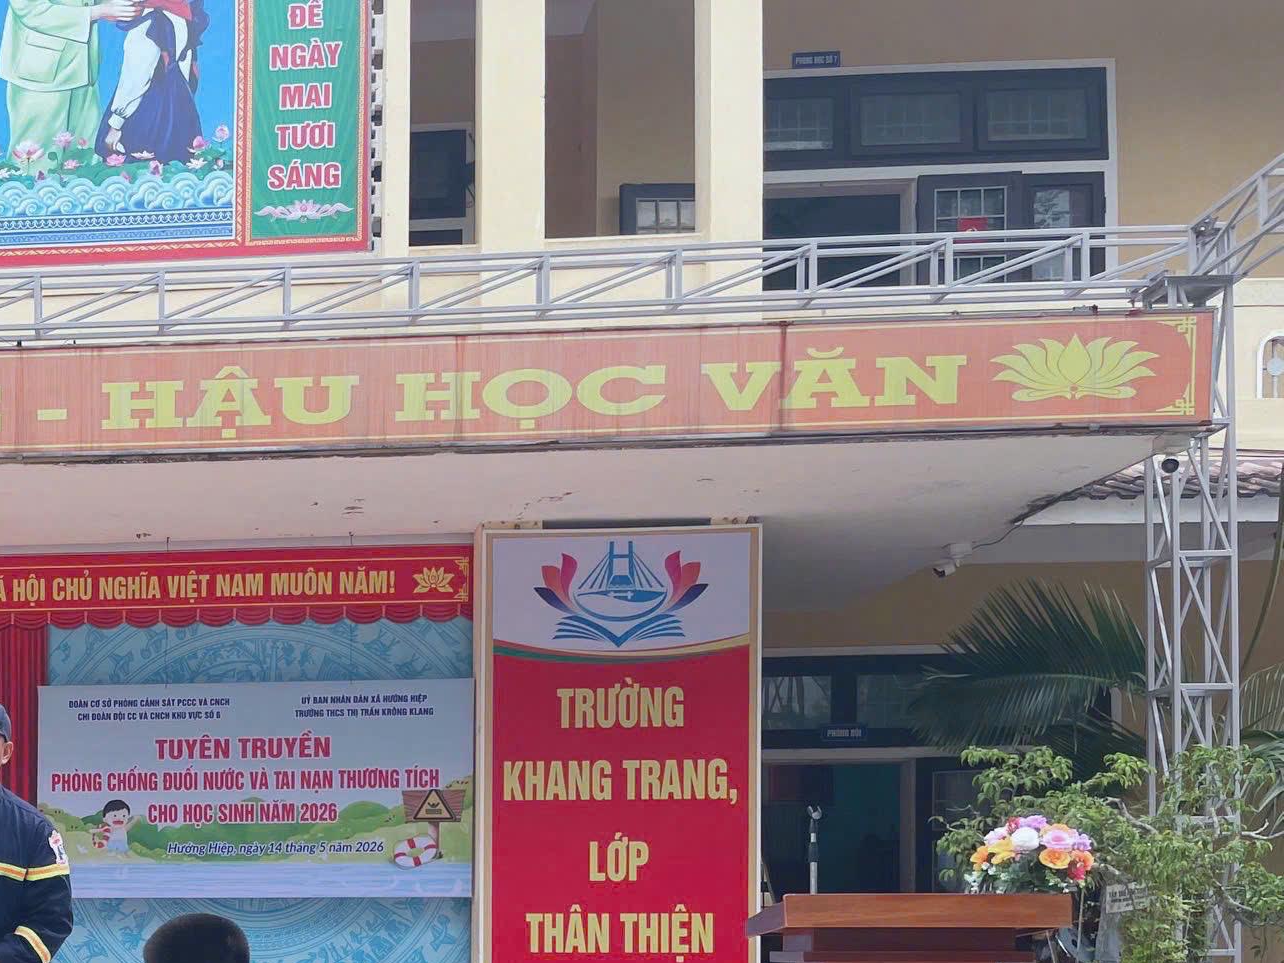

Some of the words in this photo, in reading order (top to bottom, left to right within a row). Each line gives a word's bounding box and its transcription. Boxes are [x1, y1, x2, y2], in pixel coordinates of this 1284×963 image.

[269, 38, 342, 70] NGÀY
[279, 82, 332, 110] MAI
[275, 120, 335, 150] TƯƠI
[267, 159, 341, 191] SÁNG
[37, 408, 68, 420] -
[101, 365, 360, 438] HẬU
[395, 364, 666, 429] HỌC
[702, 346, 967, 411] VĂN
[12, 573, 46, 606] HỘI
[52, 569, 92, 601] CHỦ
[99, 572, 161, 600] NGHĨA
[167, 570, 210, 603] VIỆT
[216, 574, 264, 596] NAM
[270, 567, 333, 596] MUÔN
[340, 566, 396, 594] NĂM!
[78, 712, 90, 720] CHI
[128, 712, 137, 720] CC
[172, 712, 186, 720] KHU
[114, 698, 138, 708] PHÒNG
[162, 697, 175, 706] SÁT
[177, 698, 196, 706] PCCC
[198, 696, 208, 706] VÀ
[326, 708, 344, 717] THCS
[410, 708, 434, 716] KLANG
[556, 677, 684, 728] TRƯỜNG
[155, 734, 230, 760] TUYÊN
[238, 730, 332, 760] TRUYỀN
[51, 768, 102, 792] PHÒNG
[108, 764, 158, 792] CHỐNG
[163, 765, 198, 791] ĐUỐI
[204, 767, 244, 790] NƯỚC
[249, 767, 269, 790] VÀ
[274, 770, 296, 790] TAI
[300, 769, 334, 794] NẠN
[338, 767, 400, 789] THƯƠNG
[404, 765, 440, 788] TÍCH
[503, 760, 612, 801] KHANG
[622, 758, 738, 805] TRANG,
[148, 804, 178, 824] CHO
[182, 804, 212, 828] HỌC
[218, 803, 255, 823] SINH
[260, 800, 295, 822] NĂM
[300, 802, 338, 822] 2026
[168, 842, 206, 856] Hướng
[208, 842, 236, 856] Hiệp,
[240, 841, 266, 856] ngày
[269, 842, 282, 853] 14
[285, 842, 316, 854] tháng
[319, 842, 326, 853] 5
[328, 842, 352, 853] năm
[356, 841, 384, 852] 2026
[589, 832, 649, 882] LỚP
[526, 904, 610, 954] THÂN
[620, 904, 714, 963] THIỆN
